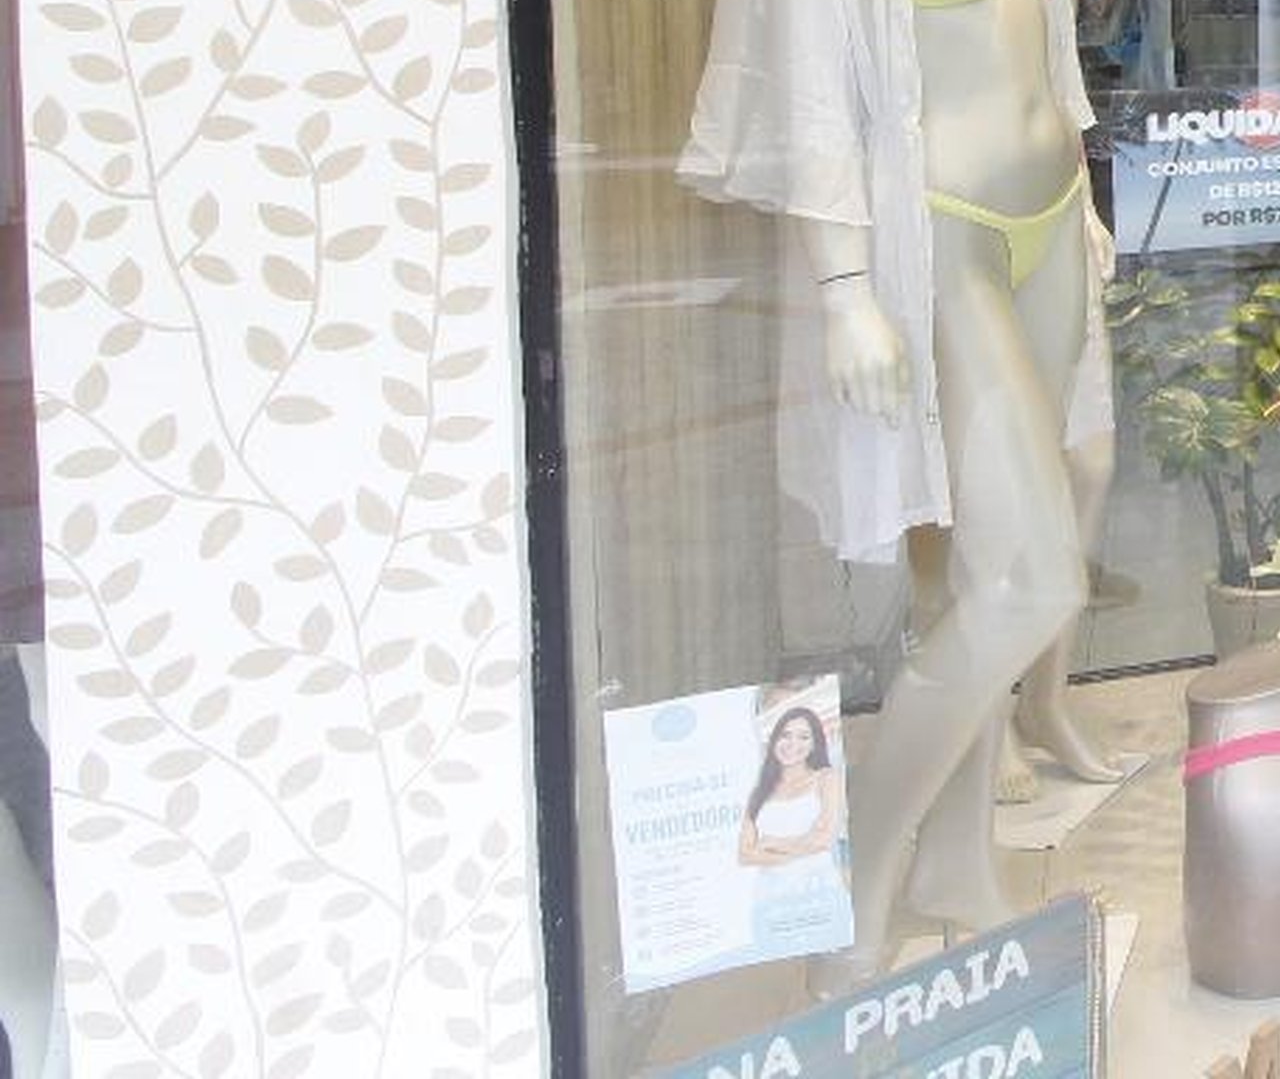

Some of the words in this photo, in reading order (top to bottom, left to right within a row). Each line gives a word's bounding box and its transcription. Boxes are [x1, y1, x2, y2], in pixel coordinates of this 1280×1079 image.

[1147, 156, 1259, 178] CONJUNTO
[1209, 184, 1237, 200] DE
[1202, 209, 1246, 227] POR
[843, 939, 1030, 1055] PRAIA
[925, 1025, 1044, 1079] IDA
